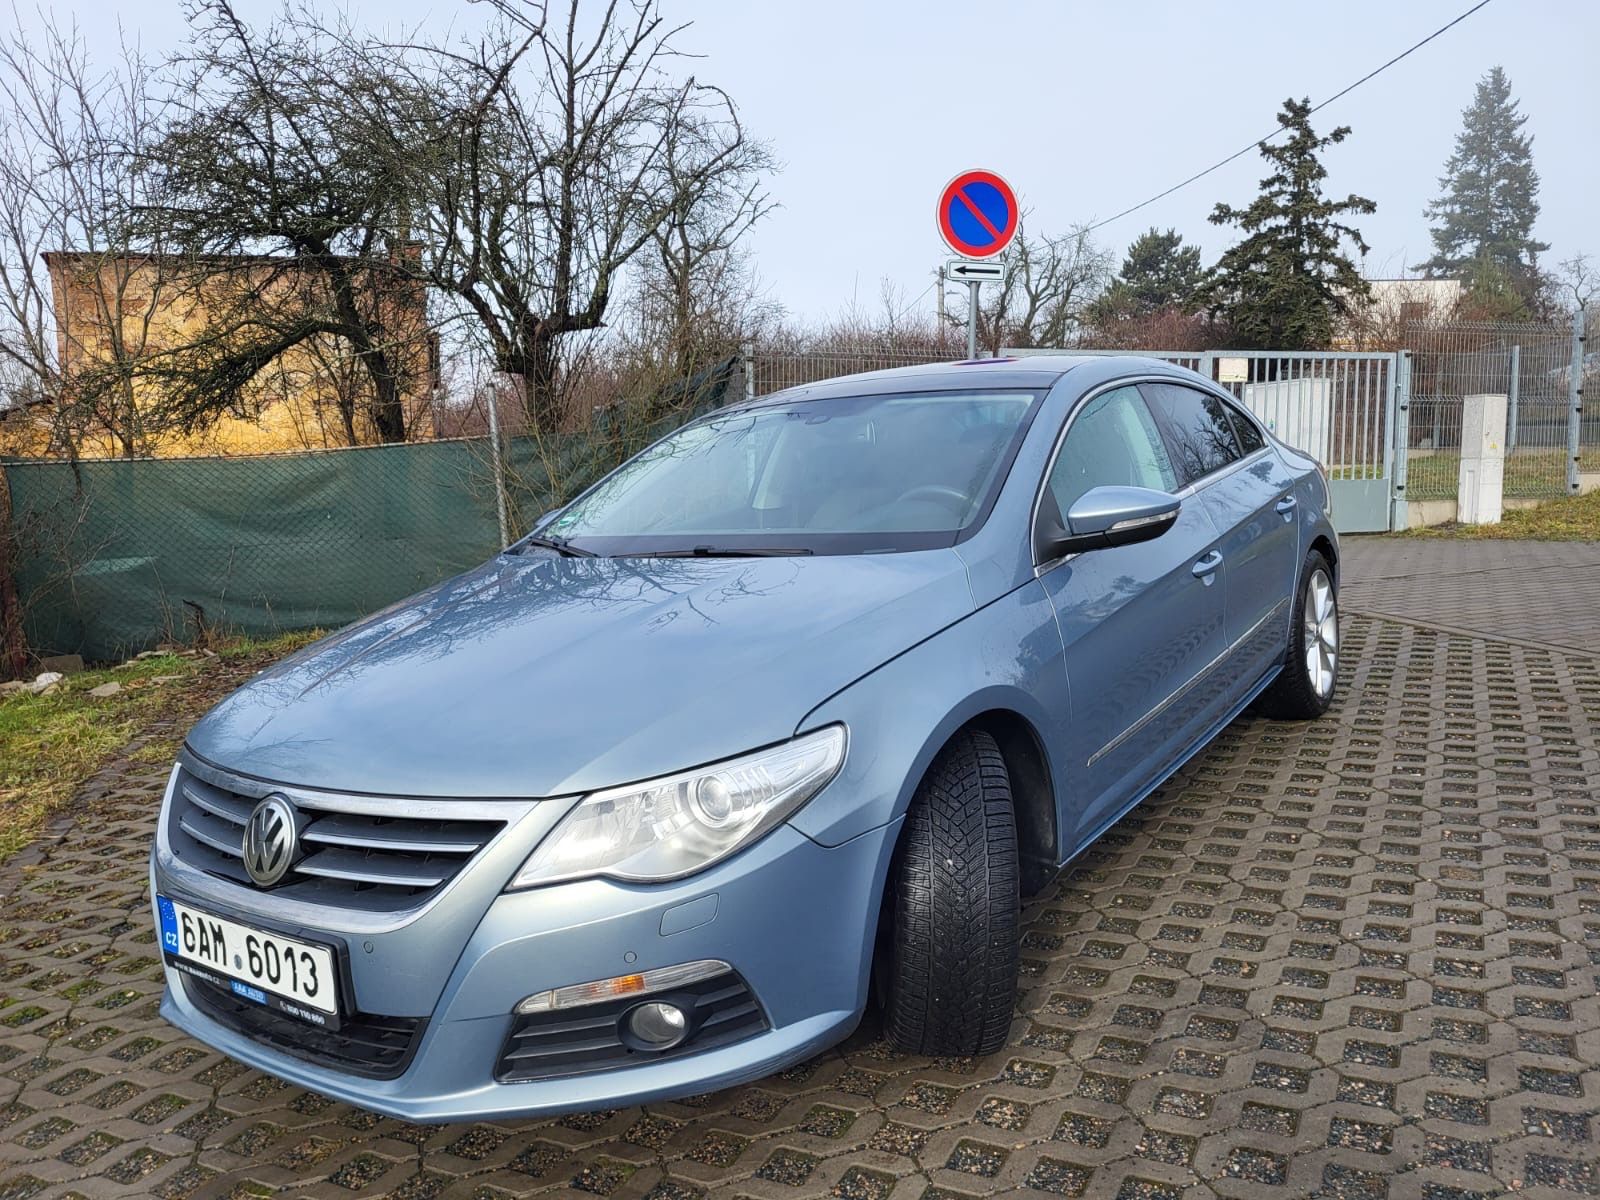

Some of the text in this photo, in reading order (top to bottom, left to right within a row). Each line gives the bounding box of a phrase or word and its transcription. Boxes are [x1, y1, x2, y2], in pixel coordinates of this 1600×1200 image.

[245, 799, 293, 880] VW
[165, 931, 178, 947] CZ
[181, 911, 227, 966] 6AM
[246, 934, 319, 998] 6013
